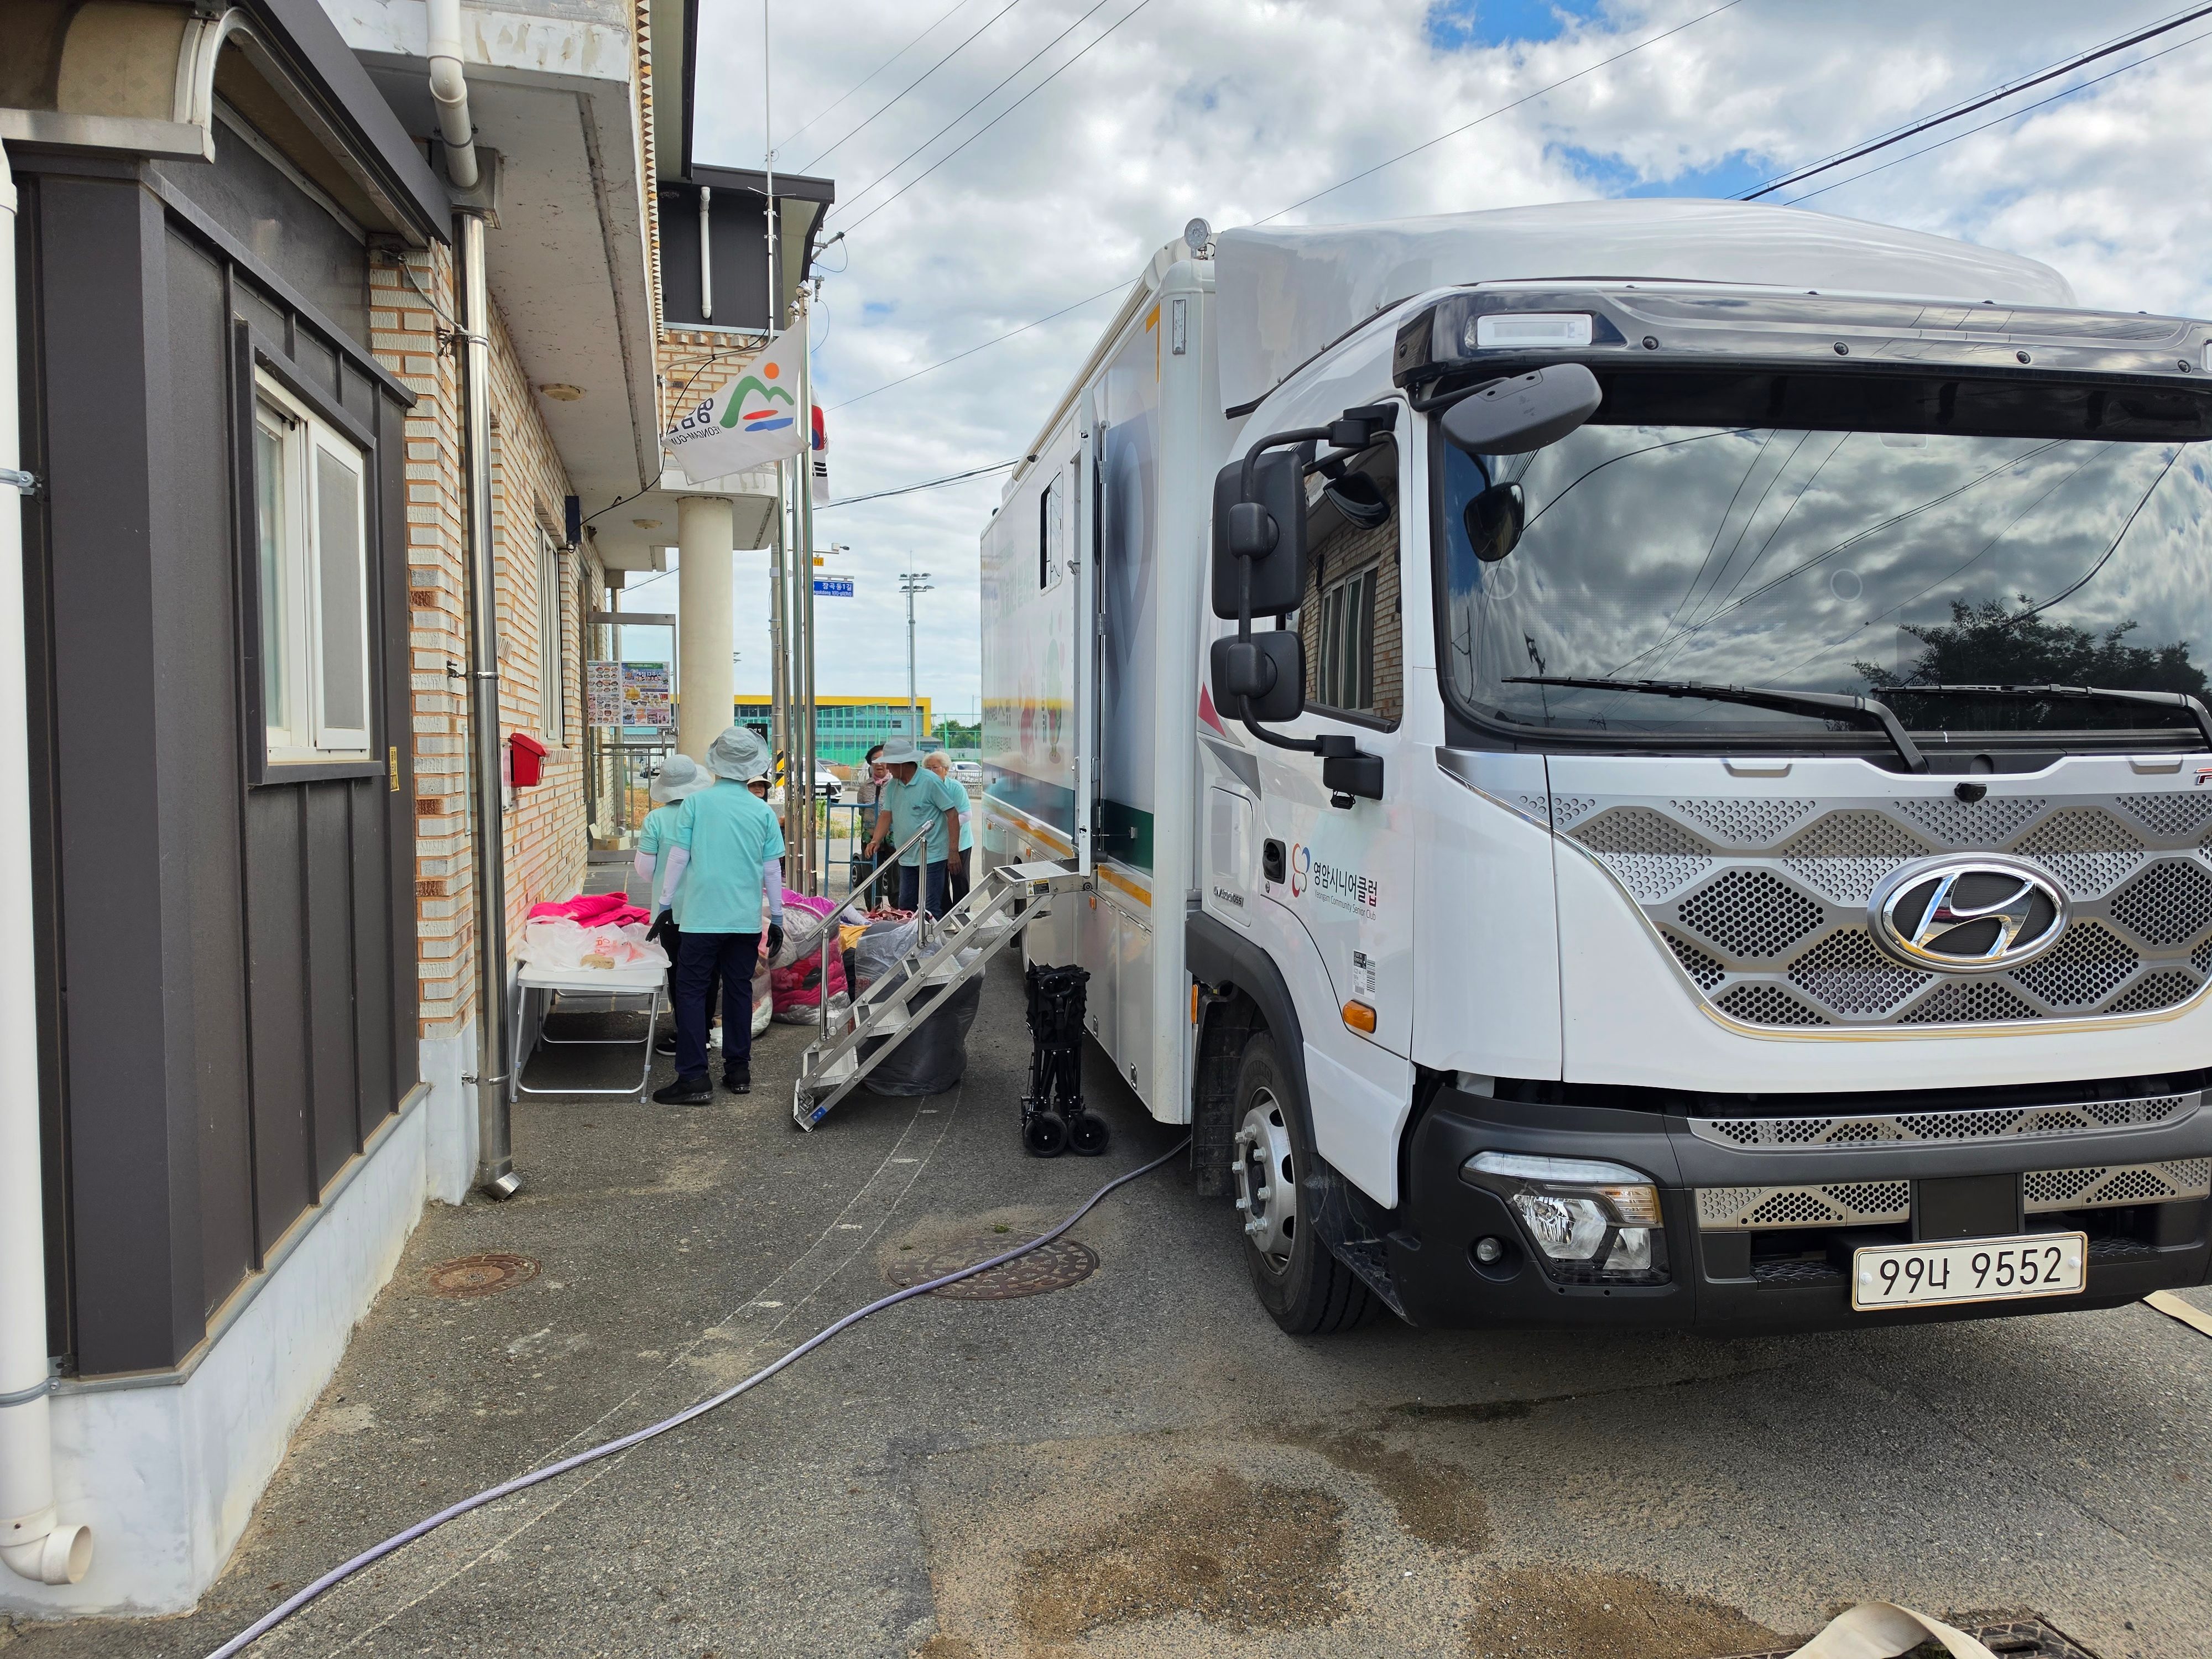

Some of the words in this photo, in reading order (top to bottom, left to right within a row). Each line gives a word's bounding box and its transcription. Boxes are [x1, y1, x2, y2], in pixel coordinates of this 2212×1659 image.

[1314, 862, 1377, 907] 영암시니어클럽
[1314, 889, 1330, 902] Yeongam
[1331, 895, 1352, 912] Community
[1353, 904, 1365, 916] Senior
[1366, 909, 1376, 920] Club
[1880, 1257, 1950, 1296] 99나
[1971, 1246, 2062, 1288] 9552
